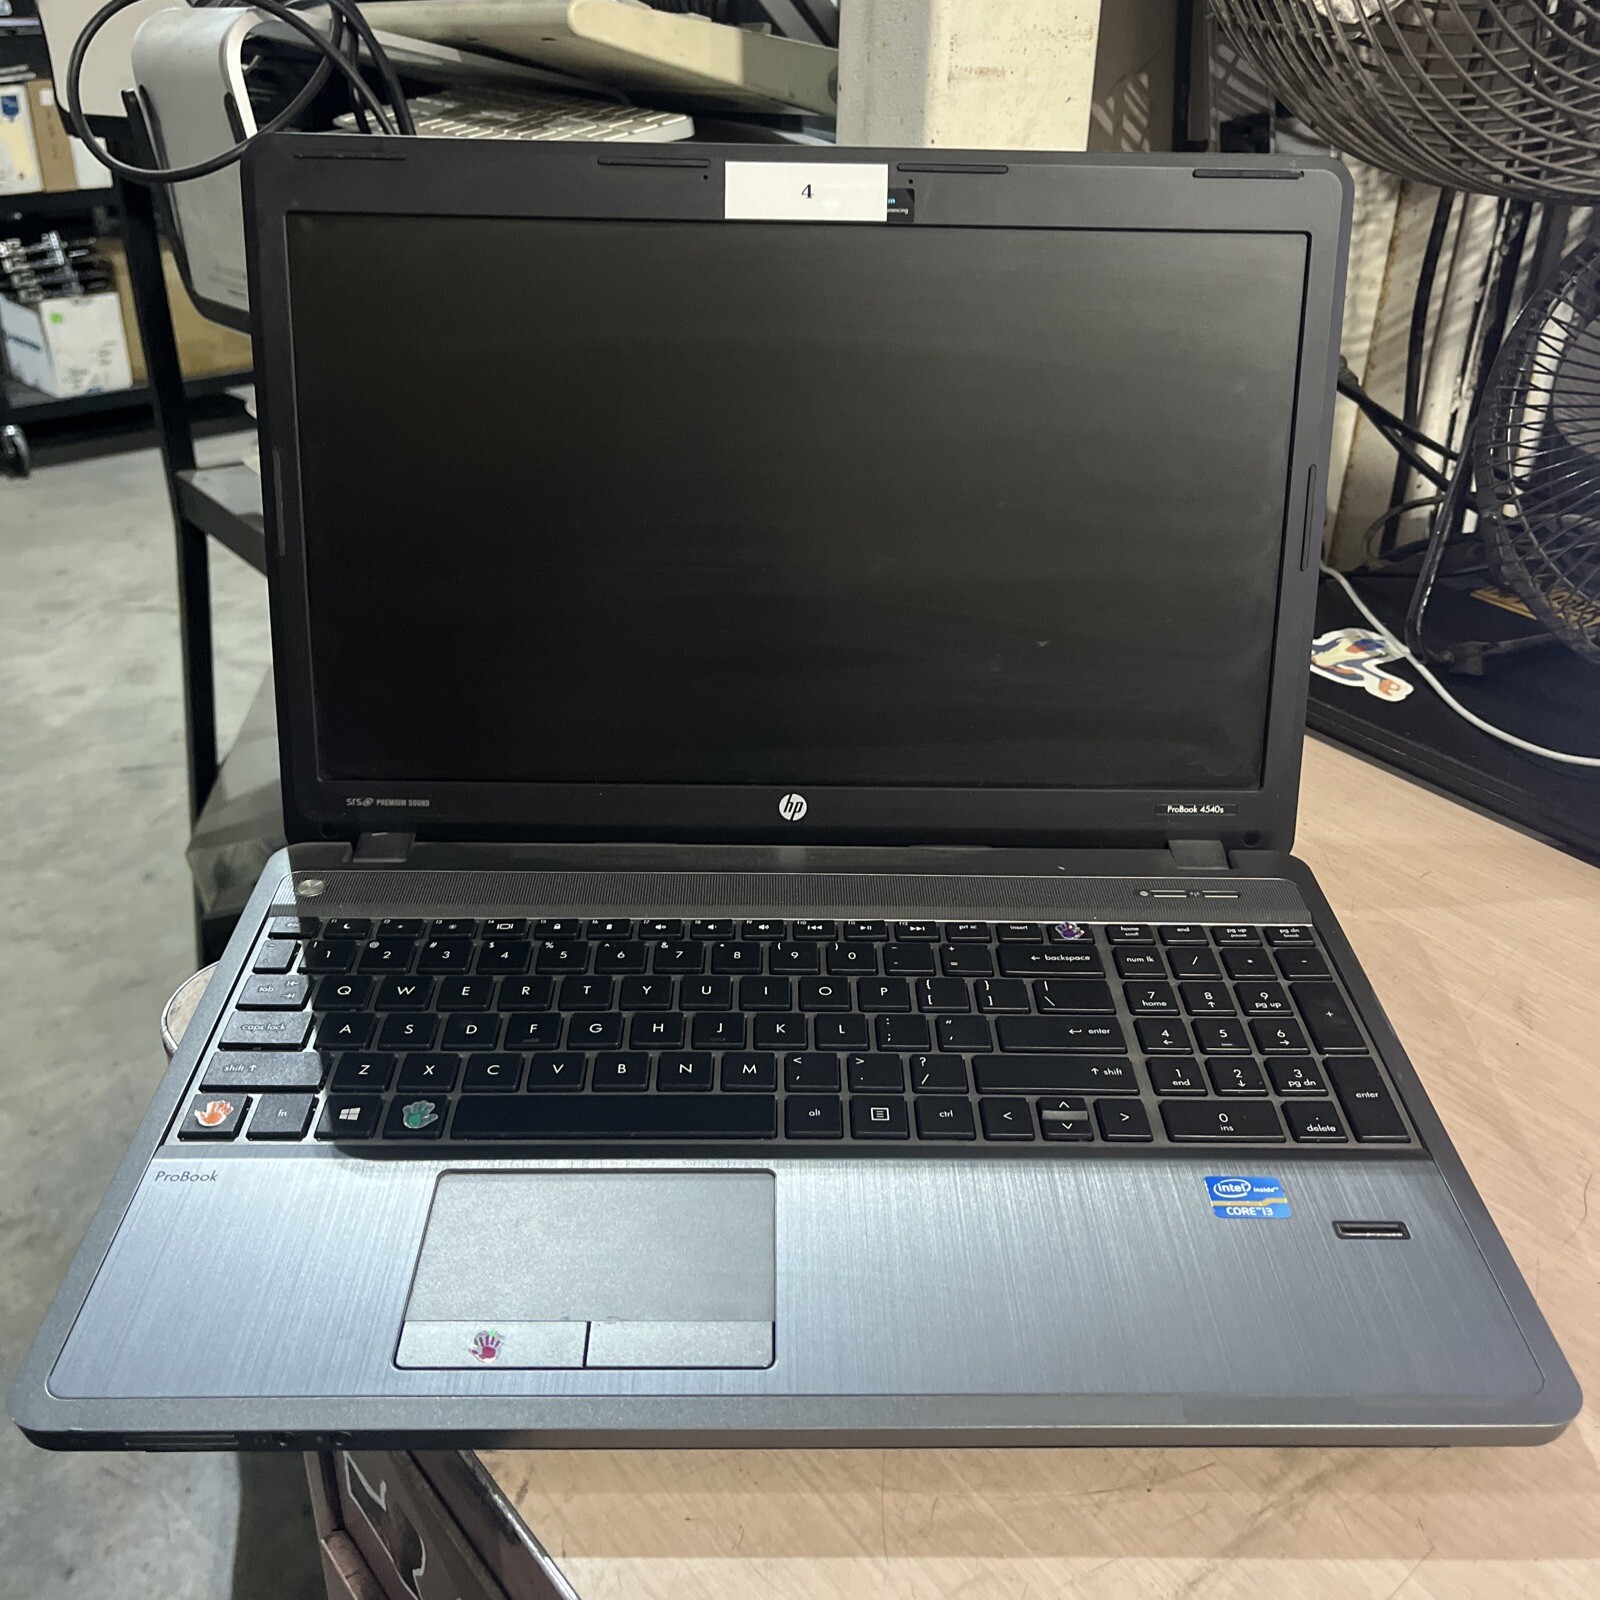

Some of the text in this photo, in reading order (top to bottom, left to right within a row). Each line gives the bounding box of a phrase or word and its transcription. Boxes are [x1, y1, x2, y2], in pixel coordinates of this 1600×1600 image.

[801, 184, 814, 199] 4
[781, 793, 805, 821] hp
[1167, 804, 1224, 813] ProBook 4540s
[660, 941, 669, 949] &
[382, 950, 392, 959] 2
[441, 950, 451, 959] 3
[500, 951, 509, 959] 4
[559, 950, 568, 959] 5
[616, 950, 626, 959] 6
[675, 950, 684, 959] 7
[733, 951, 741, 959] 8
[790, 951, 799, 959] 9
[1044, 953, 1091, 962] backspace
[259, 985, 275, 993] tab
[337, 985, 352, 996] Q
[397, 986, 416, 996] W
[461, 986, 471, 996] E
[521, 985, 531, 995] R
[583, 985, 592, 995] T
[642, 985, 652, 995] Y
[701, 985, 712, 995] U
[764, 986, 768, 996] I
[818, 986, 833, 996] O
[880, 987, 888, 996] P
[1147, 991, 1156, 1000] 7
[1204, 991, 1213, 1000] 8
[1259, 991, 1269, 1000] 9
[1141, 999, 1168, 1007] home
[242, 1022, 286, 1032] caps lock
[338, 1024, 352, 1034] A
[404, 1024, 414, 1035] S
[465, 1024, 478, 1035] D
[529, 1023, 538, 1034] F
[589, 1023, 603, 1034] G
[652, 1022, 664, 1033] H
[716, 1022, 723, 1033] J
[776, 1023, 786, 1034] K
[838, 1024, 846, 1034] L
[1087, 1027, 1111, 1035] enter
[1161, 1029, 1170, 1038] 4
[1219, 1029, 1228, 1038] 5
[1276, 1029, 1286, 1038] 6
[919, 1056, 927, 1067] ?
[224, 1064, 244, 1072] shift
[358, 1064, 371, 1075] Z
[423, 1064, 435, 1076] X
[486, 1064, 500, 1075] C
[552, 1063, 564, 1074] V
[617, 1063, 627, 1074] B
[679, 1063, 693, 1074] N
[742, 1064, 757, 1074] M
[1103, 1067, 1123, 1076] shift
[1293, 1068, 1303, 1078] 3
[1232, 1069, 1243, 1079] 2
[1172, 1078, 1191, 1086] end
[1288, 1078, 1316, 1088] pg dn
[1355, 1091, 1379, 1099] enter
[808, 1108, 821, 1117] alt
[938, 1109, 954, 1118] ctrl
[1218, 1112, 1229, 1123] 0
[1219, 1124, 1235, 1132] ins
[1306, 1123, 1337, 1132] delete
[154, 1170, 218, 1182] ProBook
